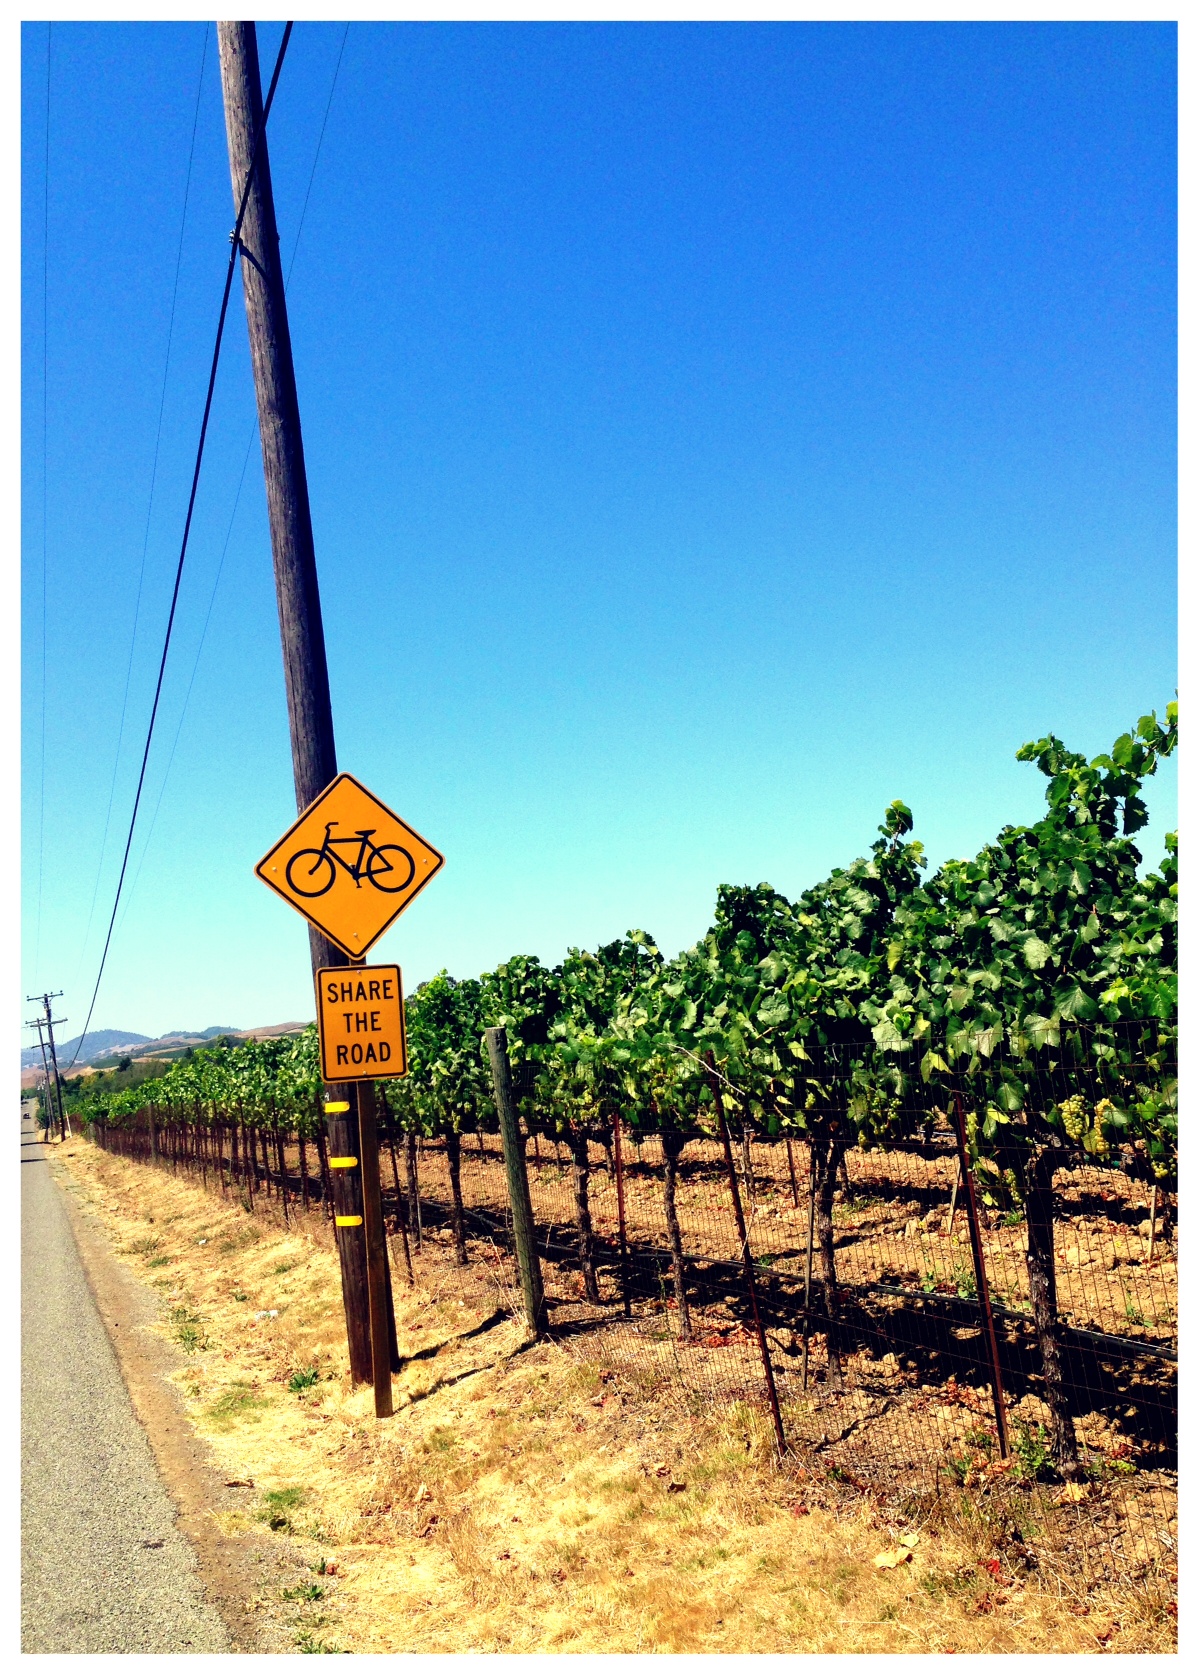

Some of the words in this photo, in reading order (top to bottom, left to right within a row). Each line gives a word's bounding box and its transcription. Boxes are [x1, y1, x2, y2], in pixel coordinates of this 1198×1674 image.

[327, 979, 394, 1003] SHARE
[343, 1011, 382, 1033] THE
[336, 1041, 391, 1065] ROAD
